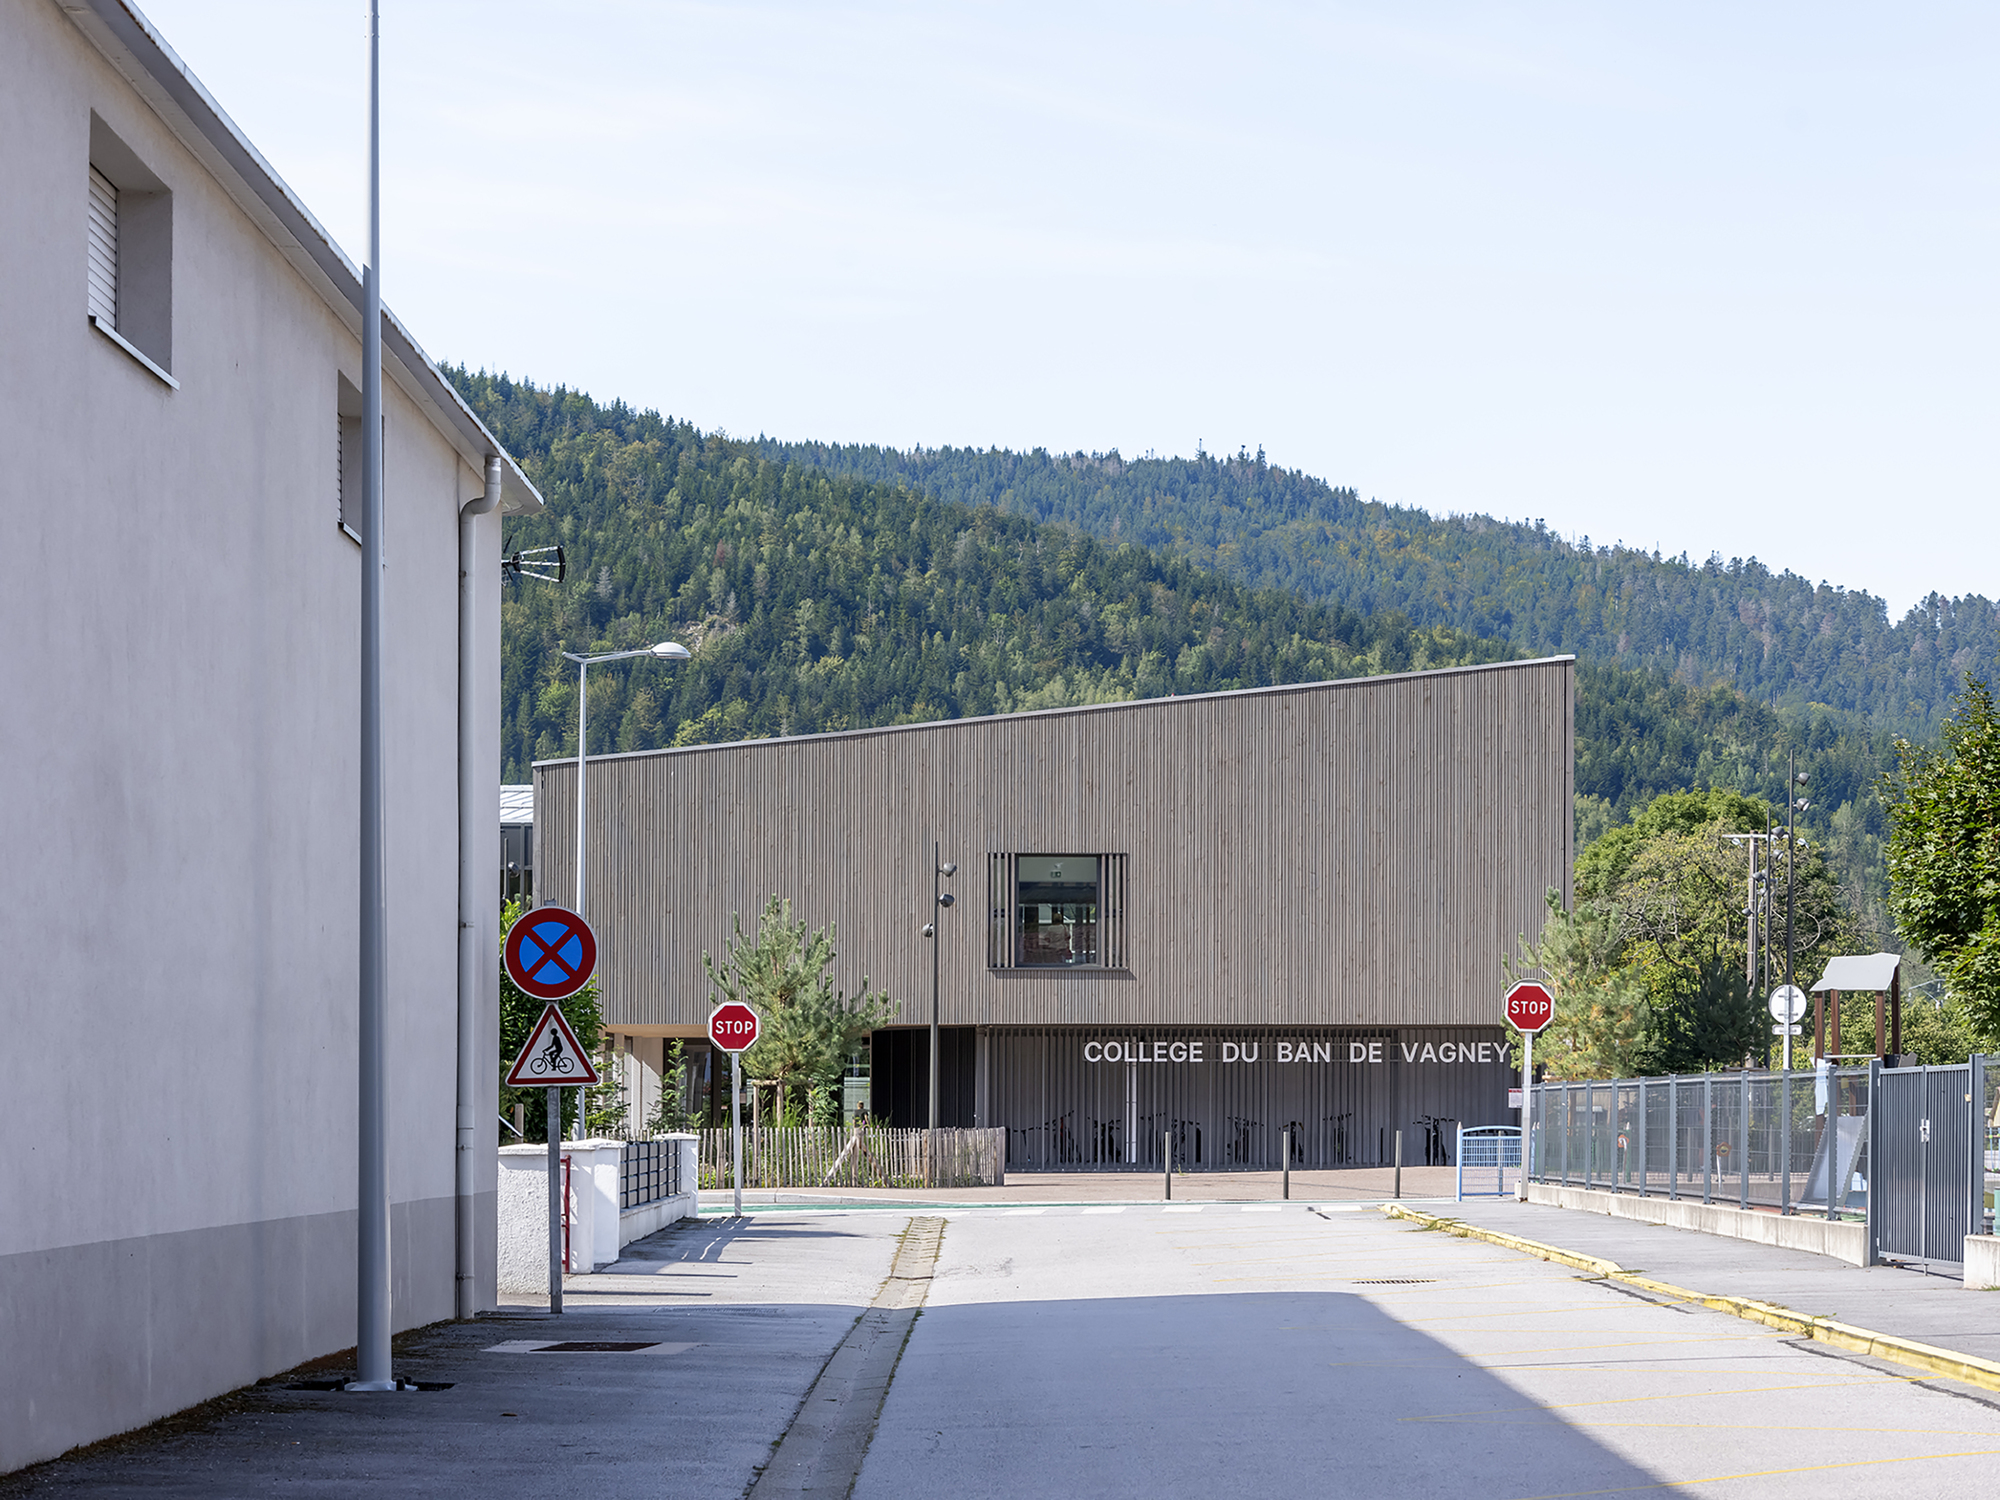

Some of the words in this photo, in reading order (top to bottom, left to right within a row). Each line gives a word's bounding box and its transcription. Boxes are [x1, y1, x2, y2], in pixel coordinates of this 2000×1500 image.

[1510, 1000, 1549, 1015] STOP
[715, 1020, 754, 1035] STOP
[1084, 1041, 1203, 1063] COLLEGE
[1222, 1041, 1259, 1063] DU
[1277, 1041, 1331, 1063] BAN
[1349, 1041, 1383, 1063] DE
[1400, 1041, 1511, 1063] VAGNEY
